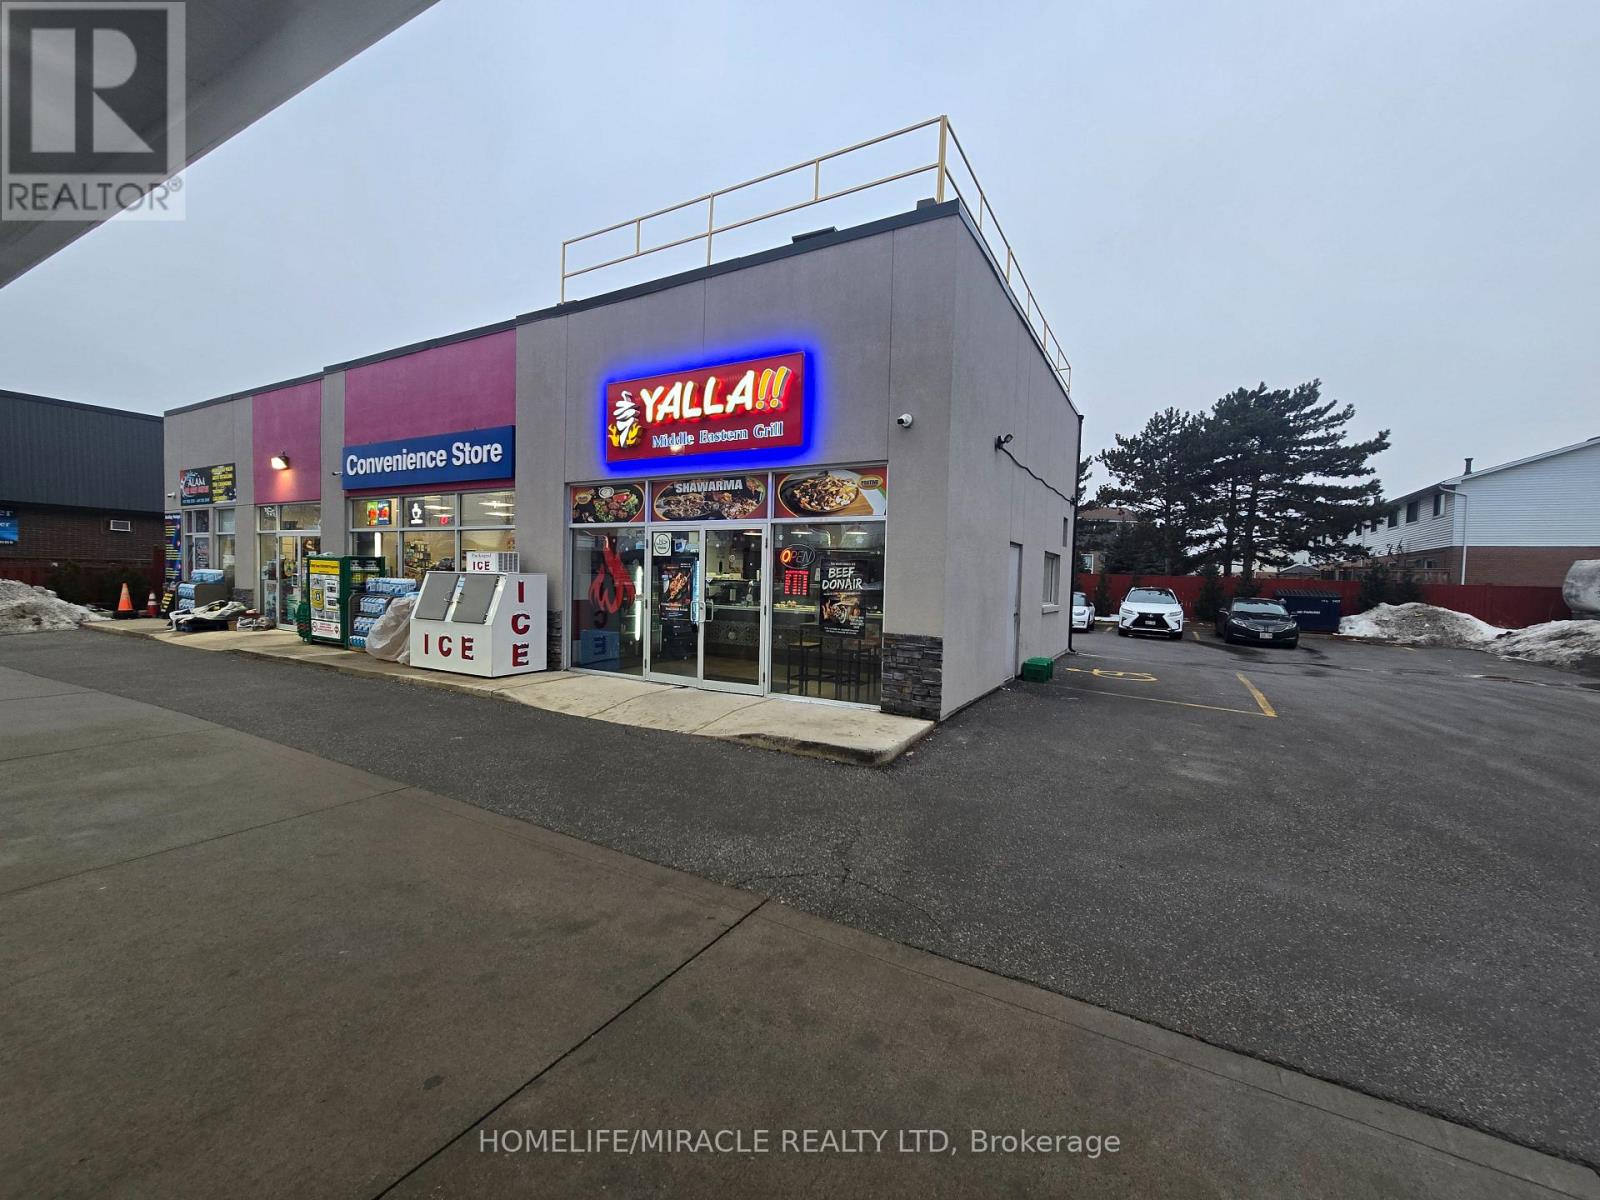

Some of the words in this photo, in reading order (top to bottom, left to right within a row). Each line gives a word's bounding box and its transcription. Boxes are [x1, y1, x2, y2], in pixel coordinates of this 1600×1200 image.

[640, 366, 792, 423] YALLA!!
[652, 431, 694, 448] Middle
[699, 428, 748, 444] Eastern
[753, 421, 784, 438] Grill
[346, 449, 448, 476] Convenience
[452, 442, 503, 467] Store
[675, 480, 743, 493] SHAWARMA
[472, 561, 490, 571] ICE
[781, 549, 813, 564] OPEN
[828, 566, 856, 579] BEEF
[821, 578, 864, 591] DONAIR
[511, 580, 531, 668] ICE
[424, 633, 475, 661] ICE
